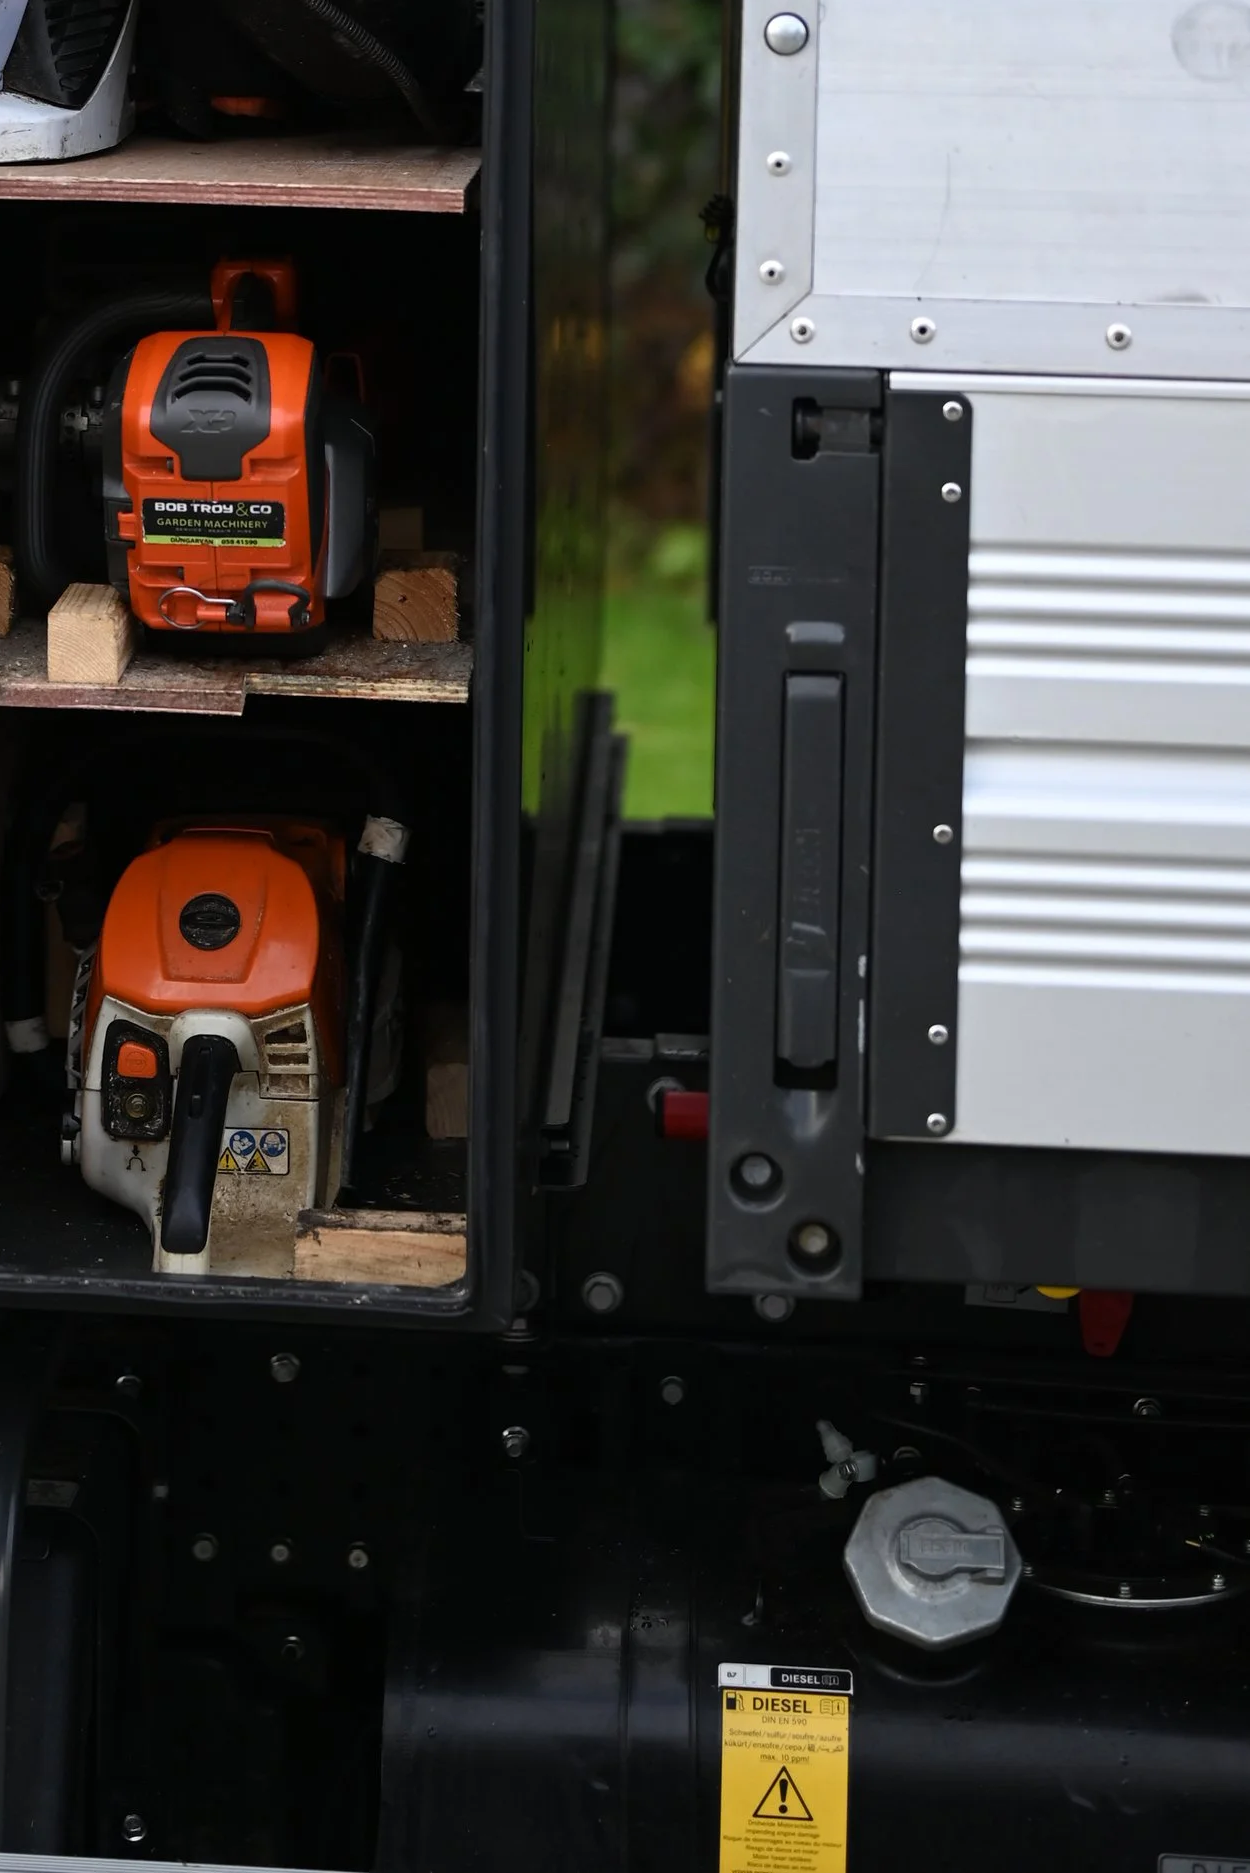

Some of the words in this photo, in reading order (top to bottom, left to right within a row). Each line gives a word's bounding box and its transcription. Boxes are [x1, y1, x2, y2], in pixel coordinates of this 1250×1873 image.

[154, 502, 188, 513] BOB
[190, 503, 234, 514] TROY
[235, 502, 250, 517] &
[250, 504, 272, 515] CO
[156, 517, 201, 527] GARDEN
[204, 519, 268, 529] MACHINERY
[781, 1673, 821, 1685] DIESEL
[752, 1696, 813, 1714] DIESEL
[761, 1715, 776, 1725] DIN
[778, 1716, 789, 1725] EN
[791, 1716, 808, 1726] 590
[781, 1753, 790, 1762] 10
